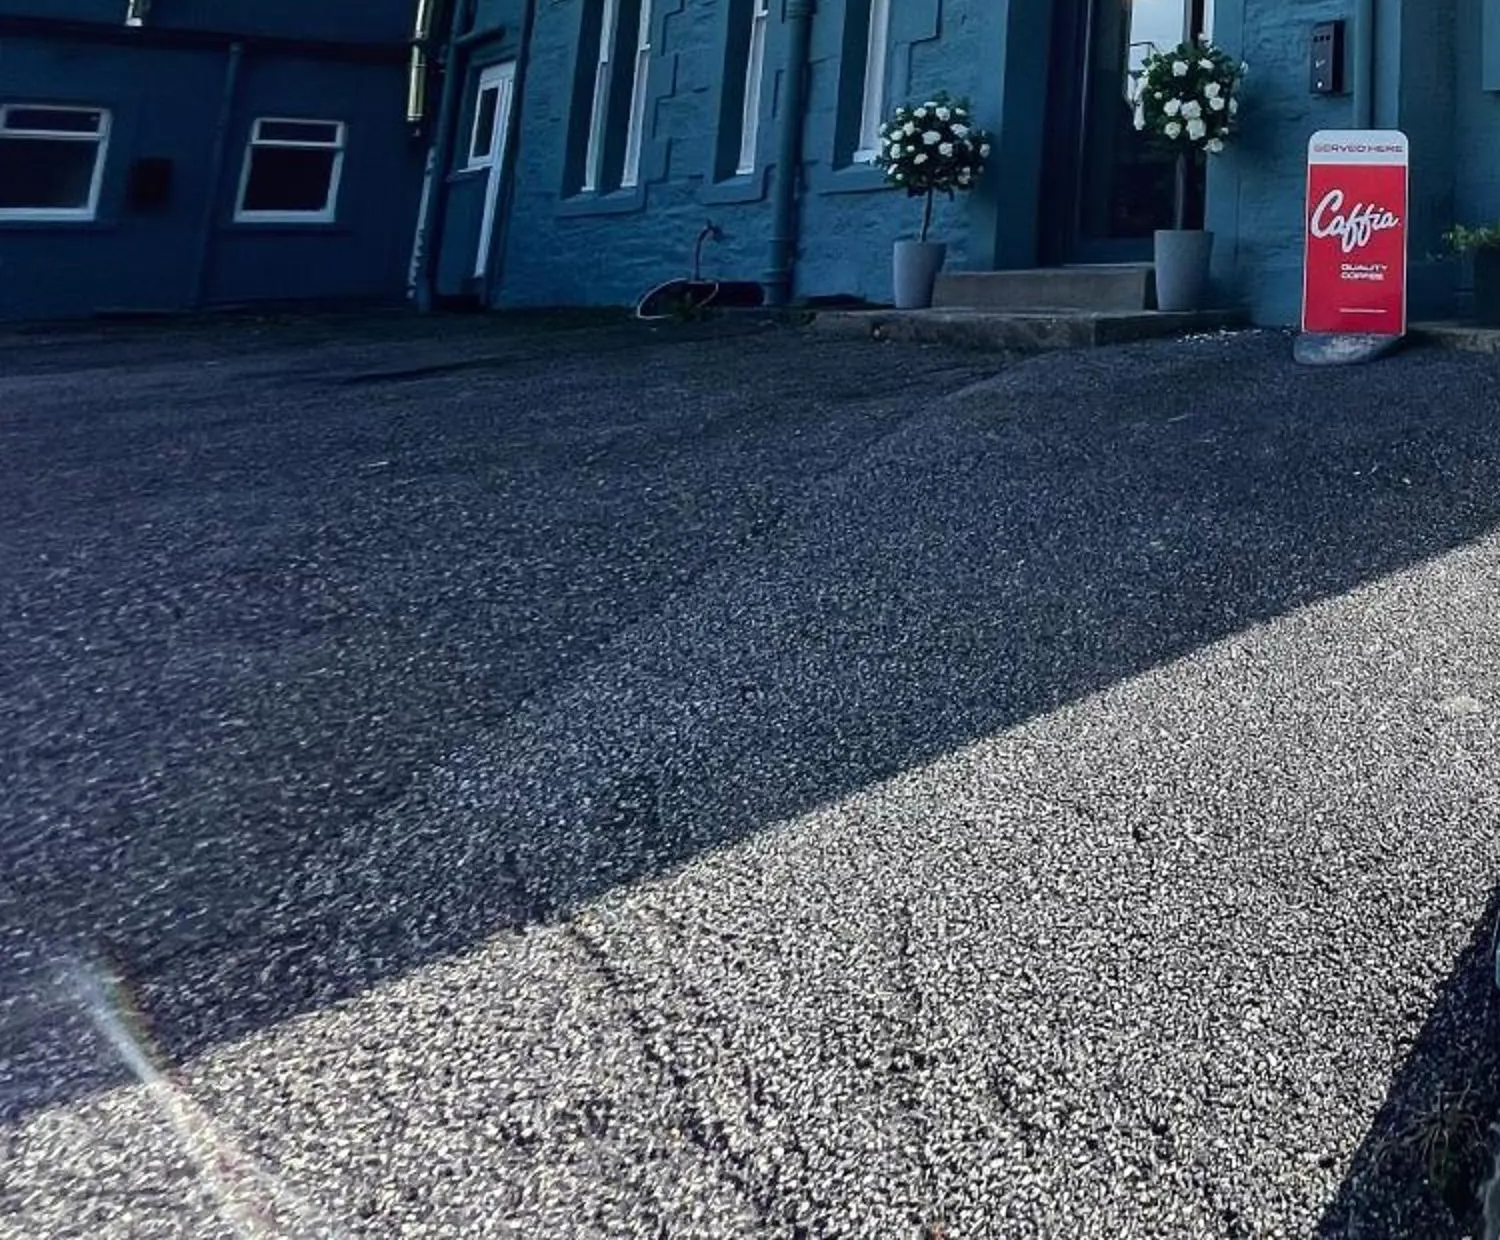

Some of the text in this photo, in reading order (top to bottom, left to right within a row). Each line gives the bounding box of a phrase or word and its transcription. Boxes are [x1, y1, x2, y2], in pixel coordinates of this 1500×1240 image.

[1314, 143, 1404, 153] SERVED HERE
[1311, 189, 1399, 253] Caffia
[1341, 263, 1388, 271] QUALITY
